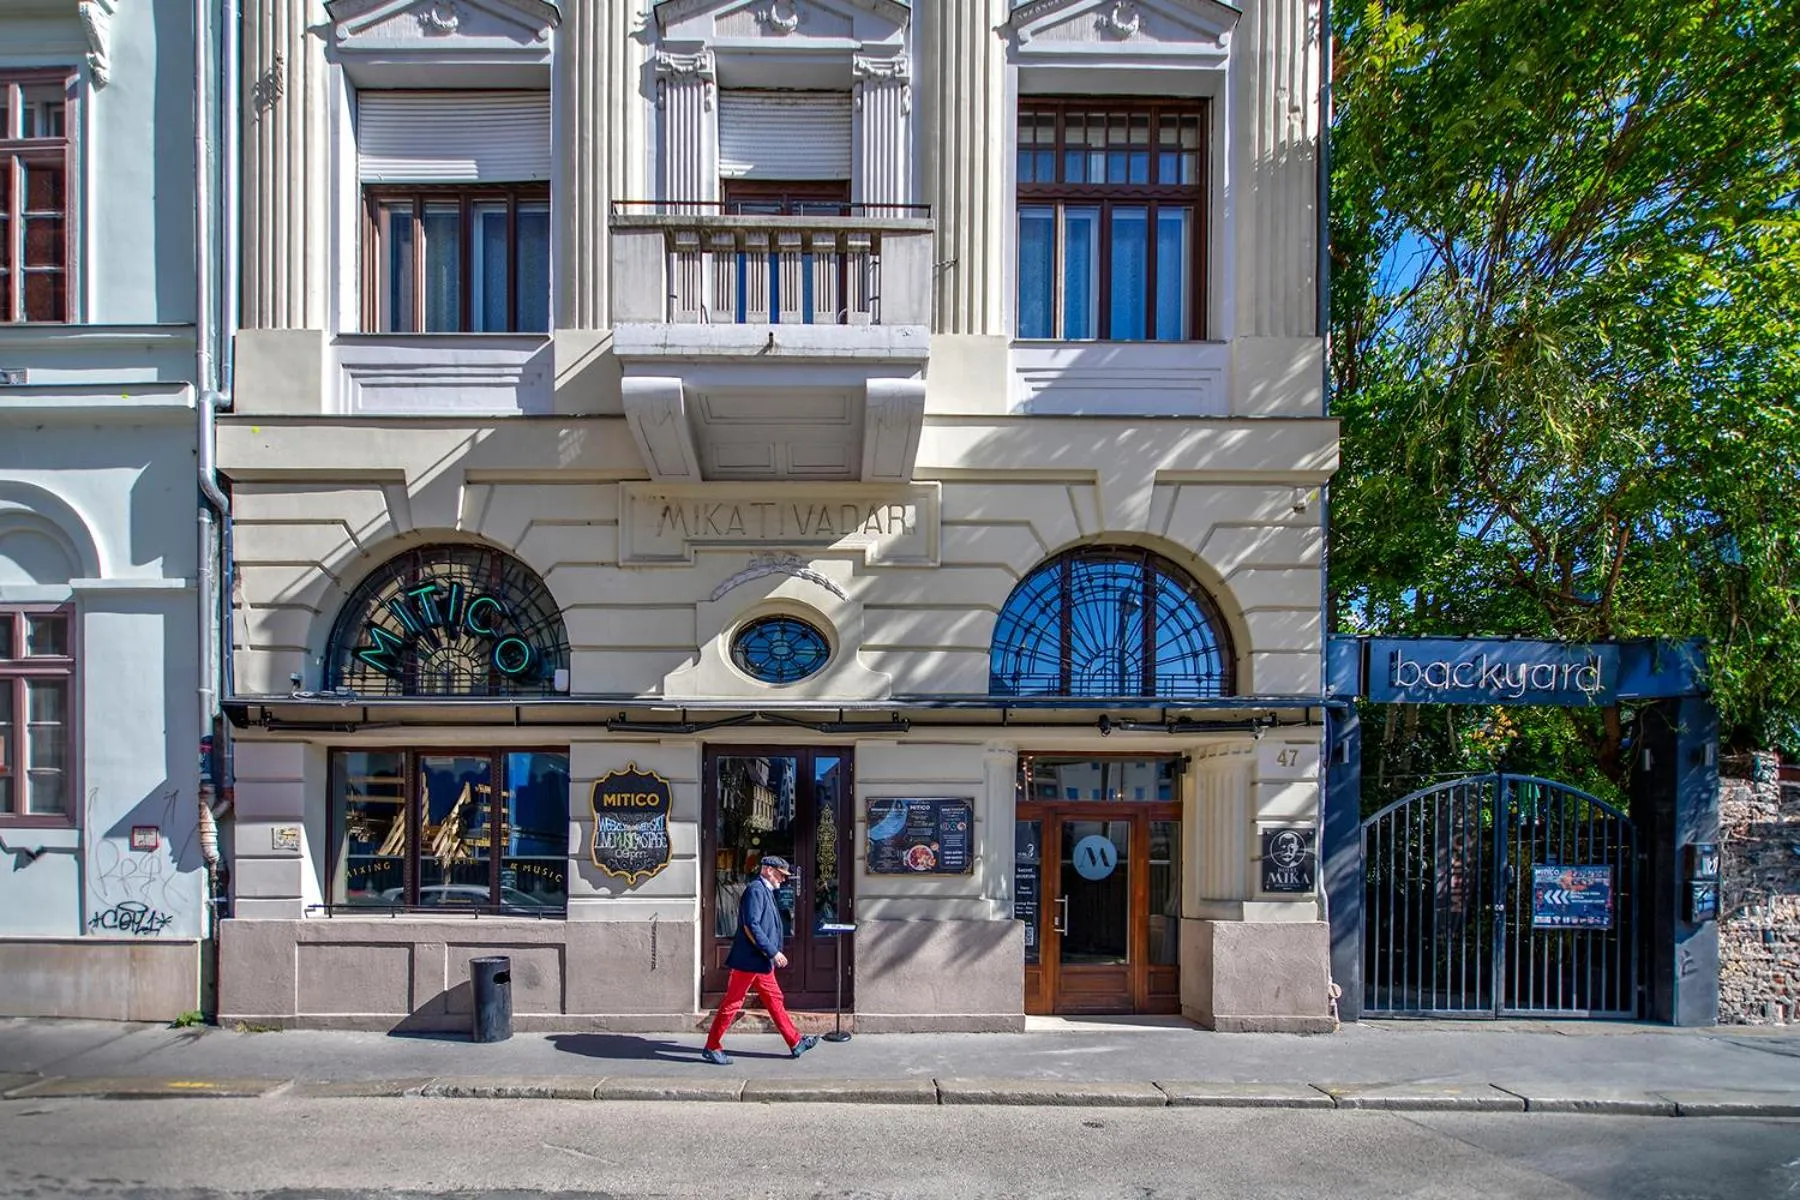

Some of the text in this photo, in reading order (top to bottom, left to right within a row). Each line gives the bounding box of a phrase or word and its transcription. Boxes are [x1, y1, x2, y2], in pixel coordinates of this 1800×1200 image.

[357, 582, 532, 674] MITICO
[1391, 648, 1603, 699] backyard
[1276, 749, 1298, 767] 47
[603, 793, 660, 807] MITICO
[522, 864, 563, 882] MUSIC
[1267, 872, 1310, 884] MIKA
